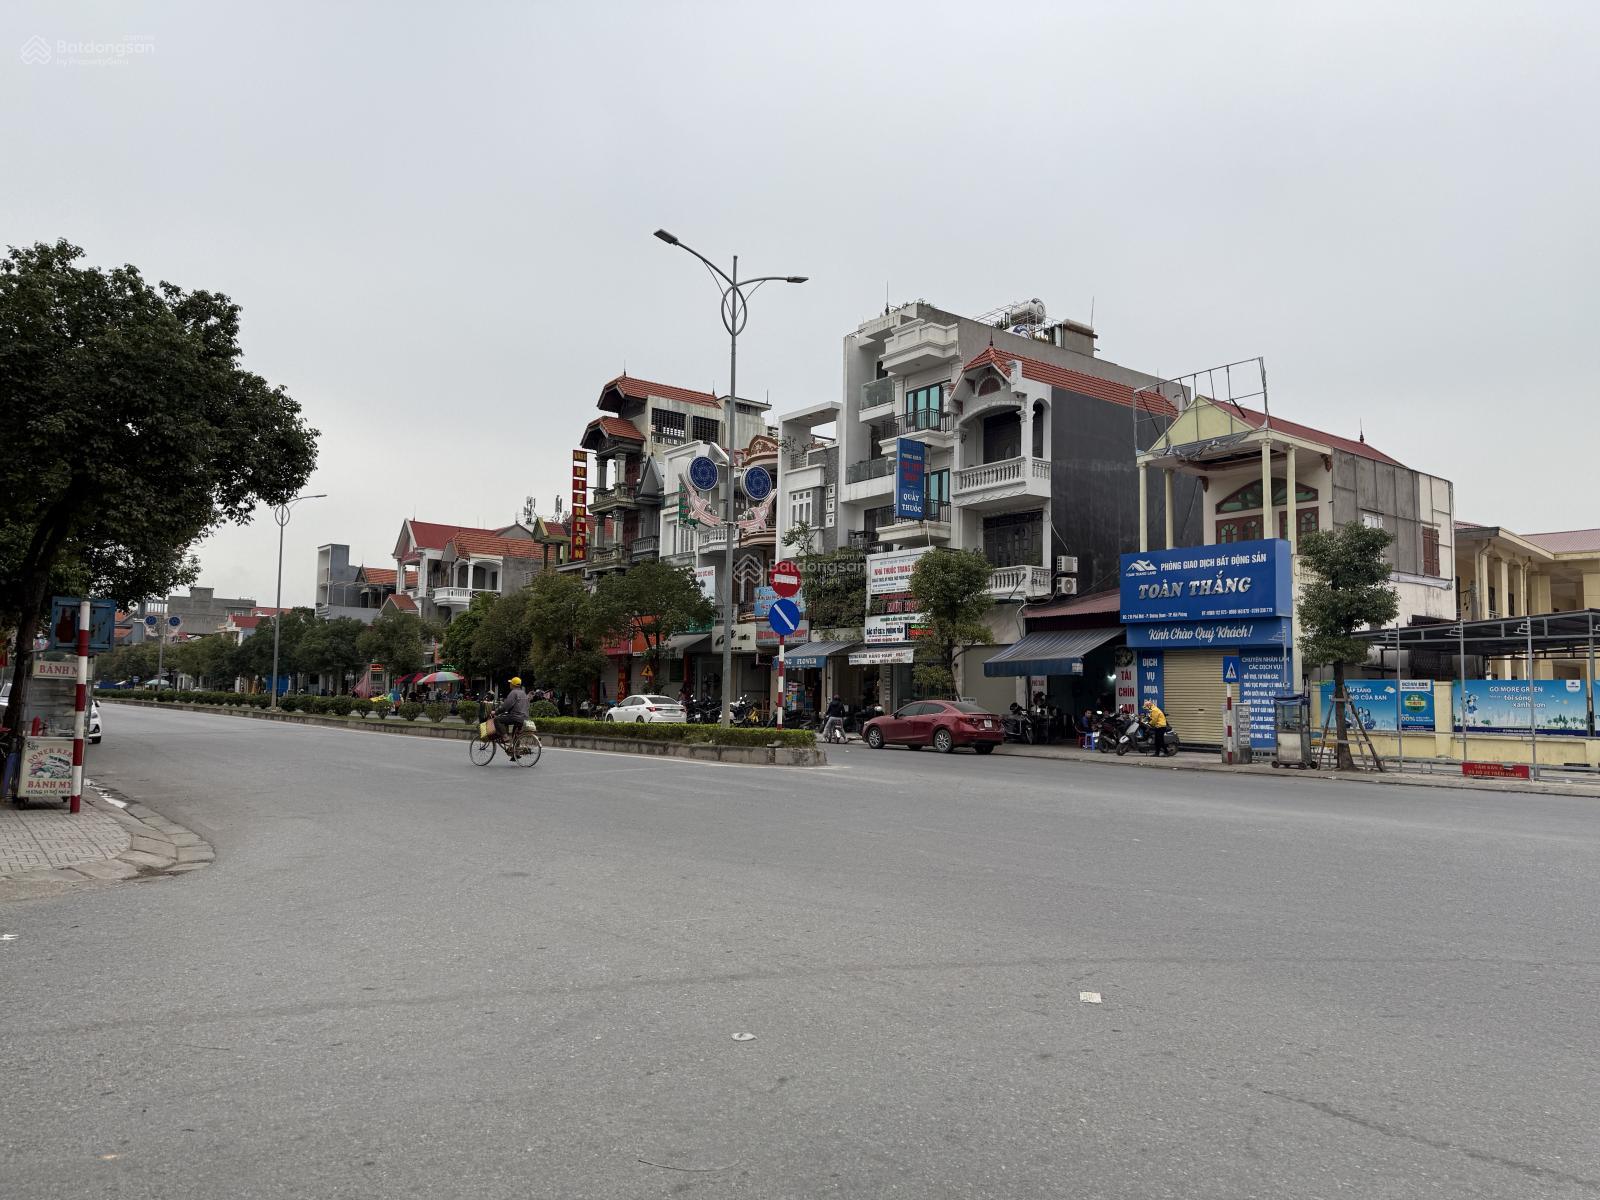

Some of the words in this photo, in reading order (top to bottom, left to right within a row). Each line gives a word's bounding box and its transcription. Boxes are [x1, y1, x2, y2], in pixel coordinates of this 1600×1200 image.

[902, 502, 922, 513] THUỐC
[1160, 560, 1182, 572] PHÒNG
[1183, 561, 1198, 570] GIAO
[1200, 559, 1215, 570] DỊCH
[1216, 555, 1230, 567] BẤT
[1231, 555, 1250, 567] ĐỘNG
[1251, 551, 1267, 563] SẢN
[1138, 579, 1184, 600] TOÀN
[1188, 570, 1252, 596] THẮNG
[1148, 628, 1169, 640] Kính
[1170, 627, 1193, 640] Chào
[1195, 626, 1215, 643] Quý
[1142, 658, 1158, 668] DỊCH
[39, 663, 69, 675] BÁNH
[1146, 671, 1156, 682] VỤ
[1144, 685, 1158, 694] MUA
